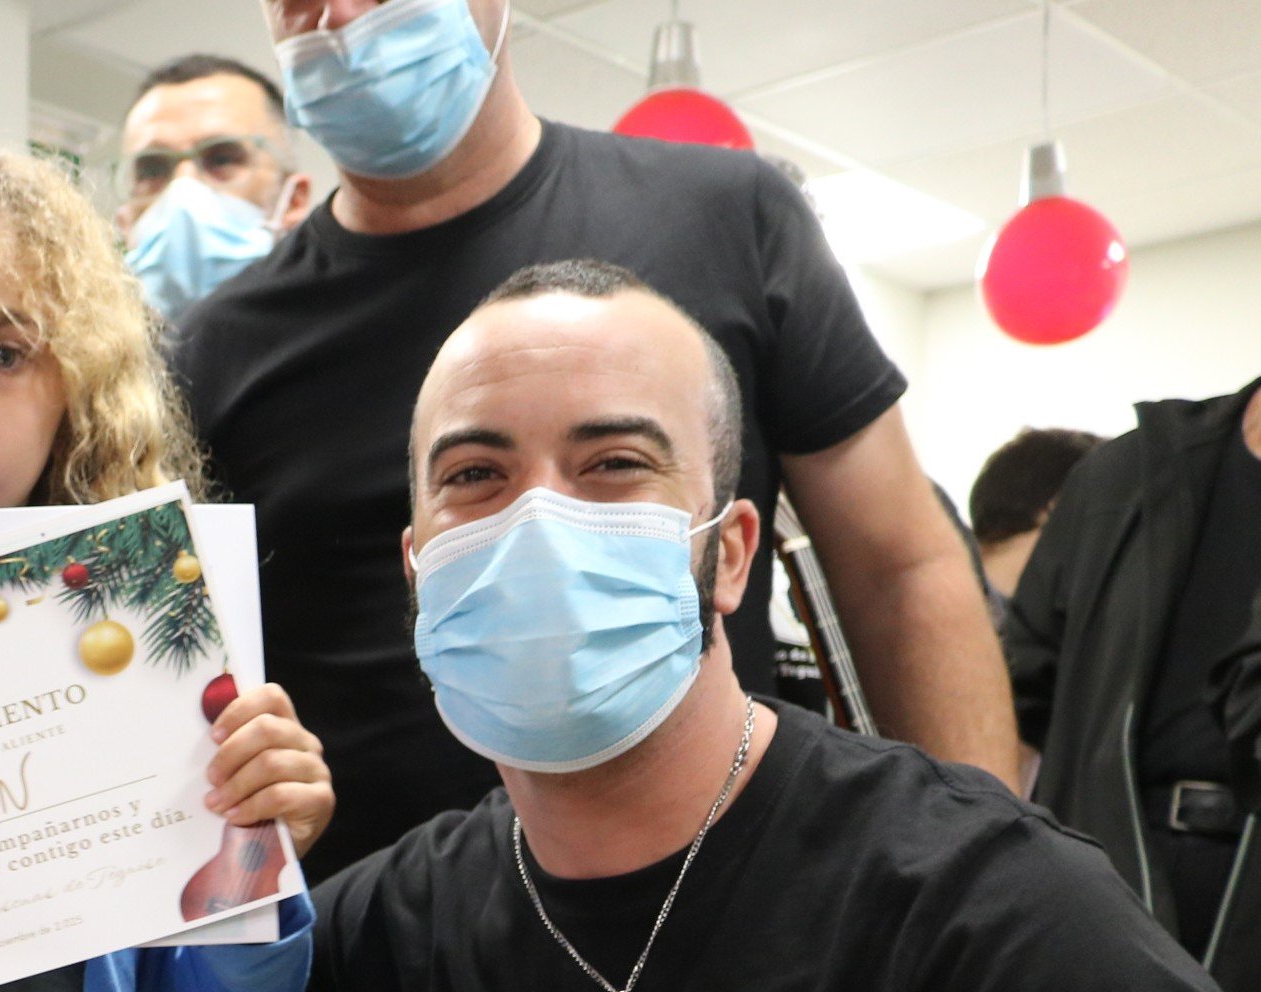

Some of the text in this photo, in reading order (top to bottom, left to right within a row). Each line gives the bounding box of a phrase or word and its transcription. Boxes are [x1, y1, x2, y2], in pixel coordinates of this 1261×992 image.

[129, 798, 142, 818] y
[7, 837, 92, 872] contigo
[98, 822, 144, 845] este
[150, 808, 193, 829] día.
